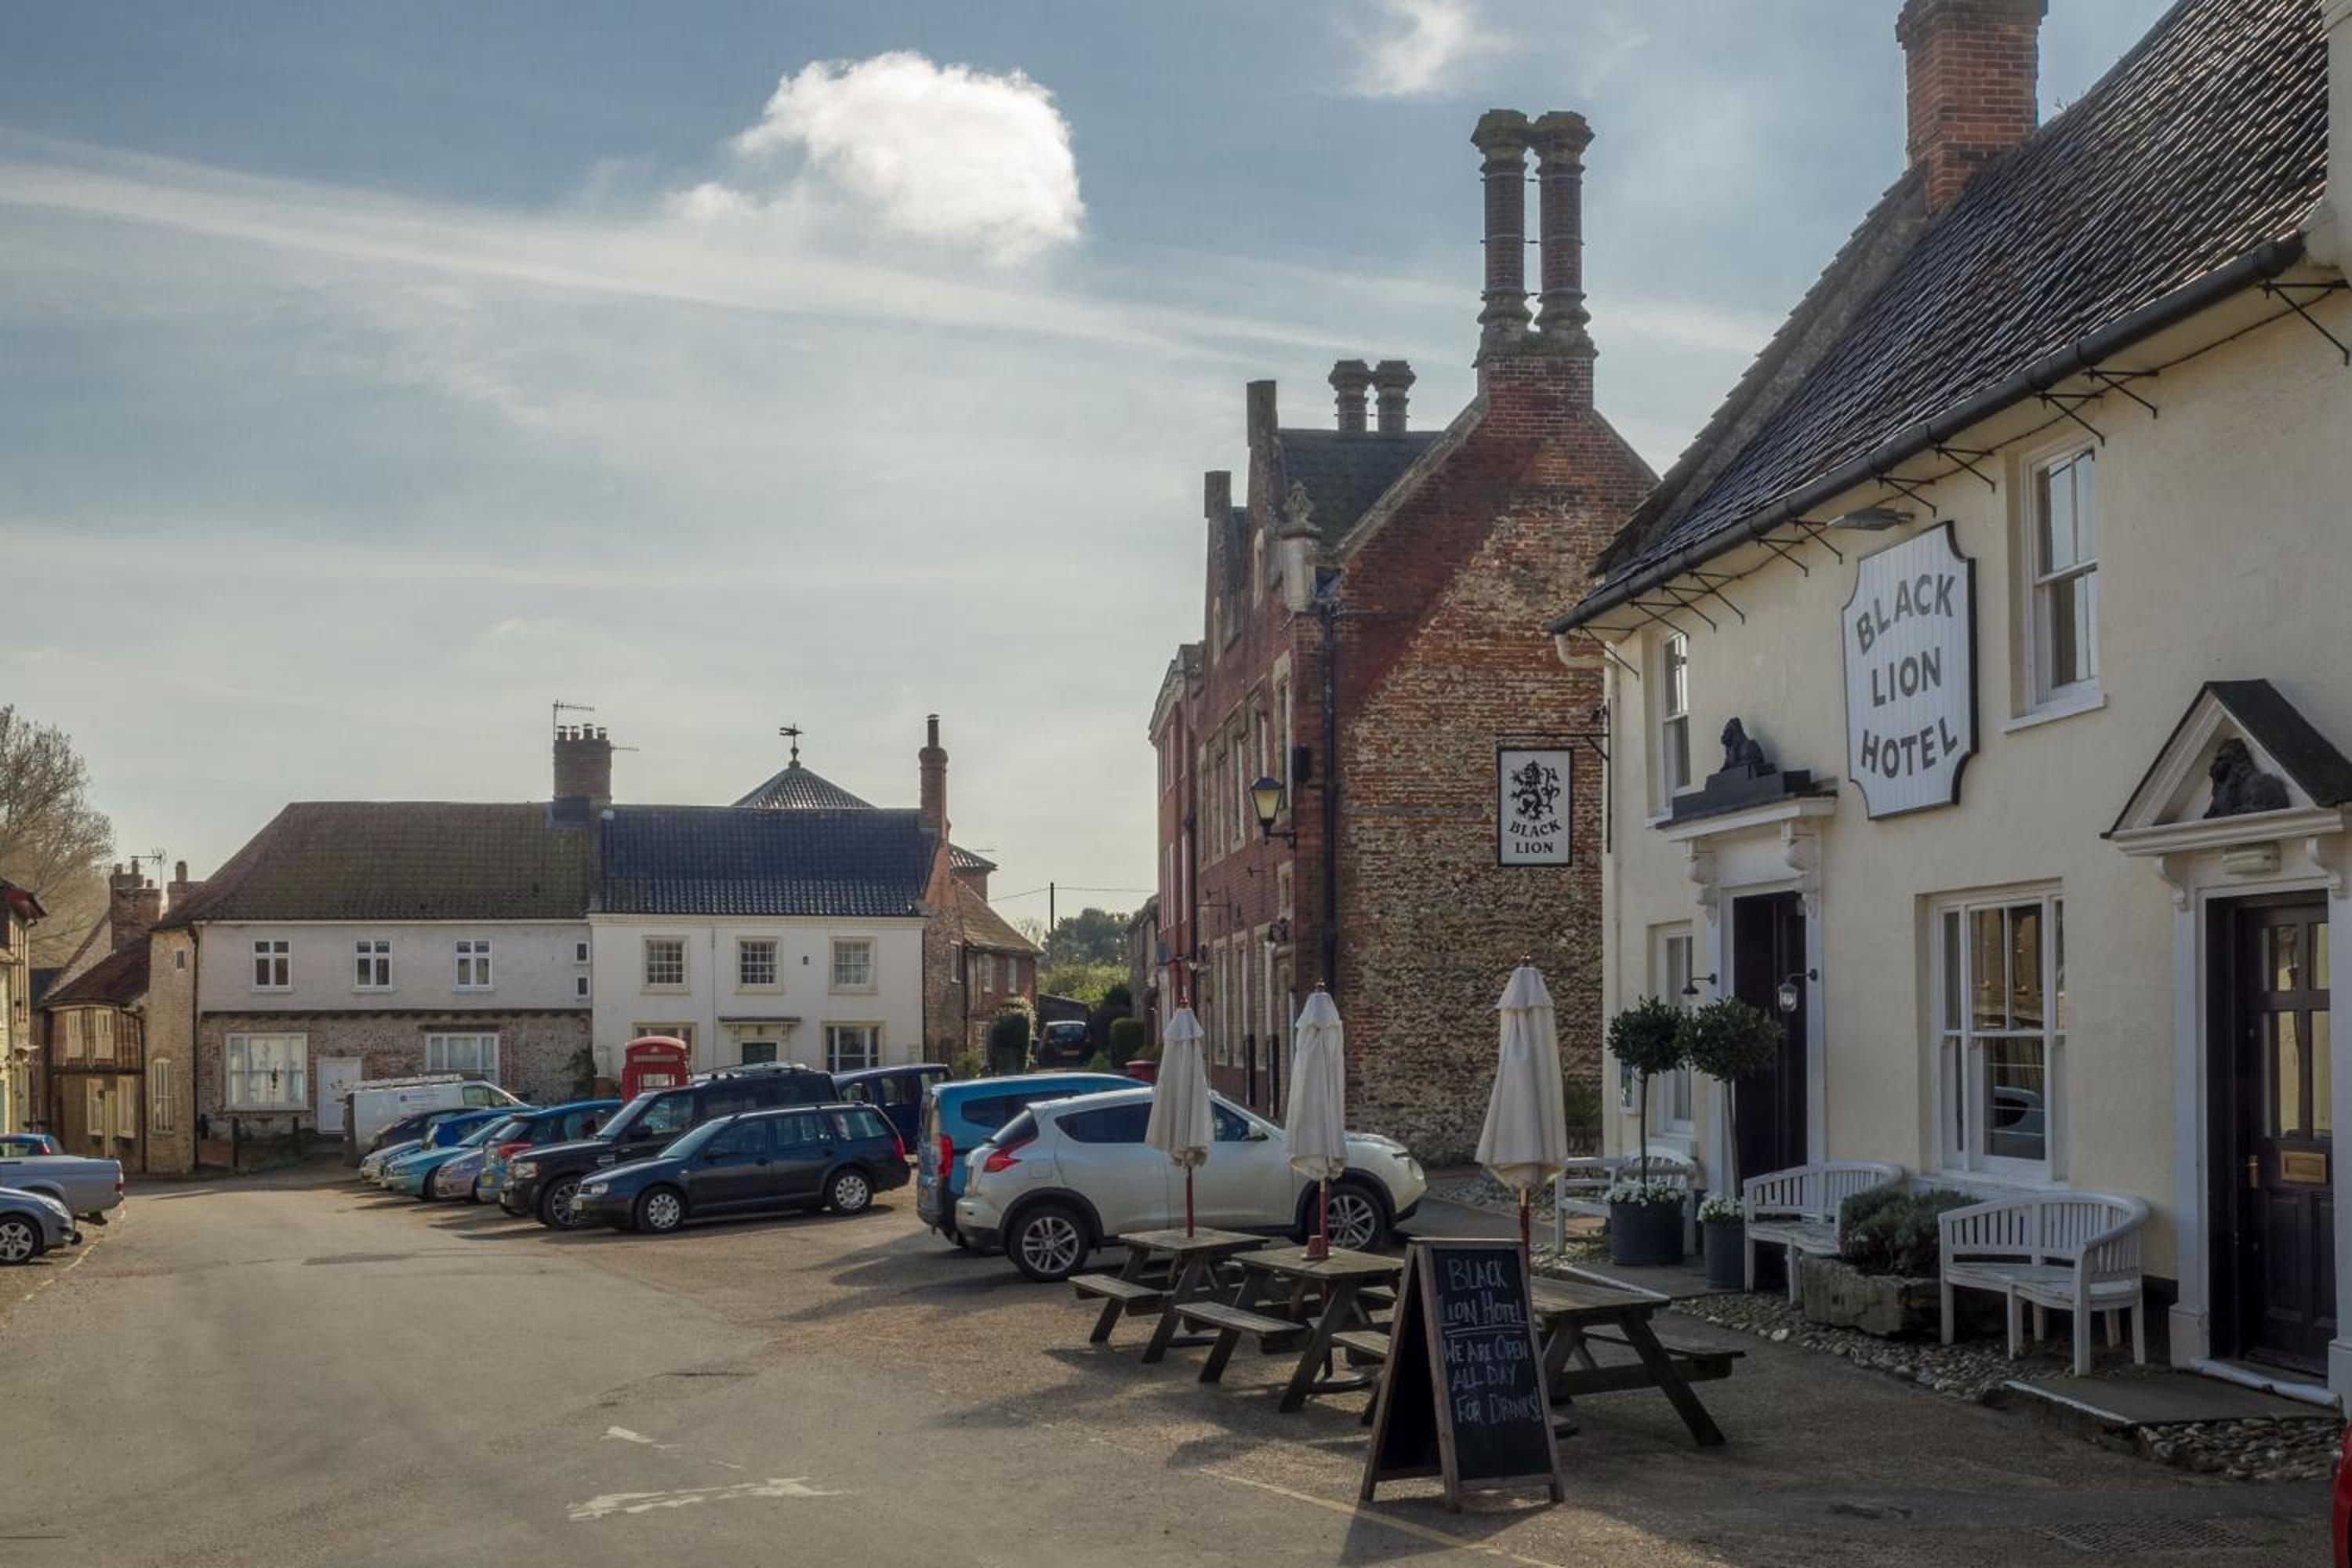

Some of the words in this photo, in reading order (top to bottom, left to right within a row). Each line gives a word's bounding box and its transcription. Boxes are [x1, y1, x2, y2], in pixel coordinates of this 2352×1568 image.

[1856, 573, 1956, 655] BLACK
[1871, 647, 1941, 707] LION
[1861, 717, 1958, 779] HOTEL
[1509, 819, 1562, 837] BLACK
[1515, 841, 1554, 854] LION
[1447, 1258, 1508, 1291] BLACK
[1481, 1290, 1529, 1325] HOTEL
[1443, 1338, 1465, 1363] WE
[1467, 1340, 1493, 1363] ARE
[1495, 1334, 1529, 1361] OPEN
[1451, 1367, 1486, 1392] ALL
[1486, 1363, 1518, 1386] DAY
